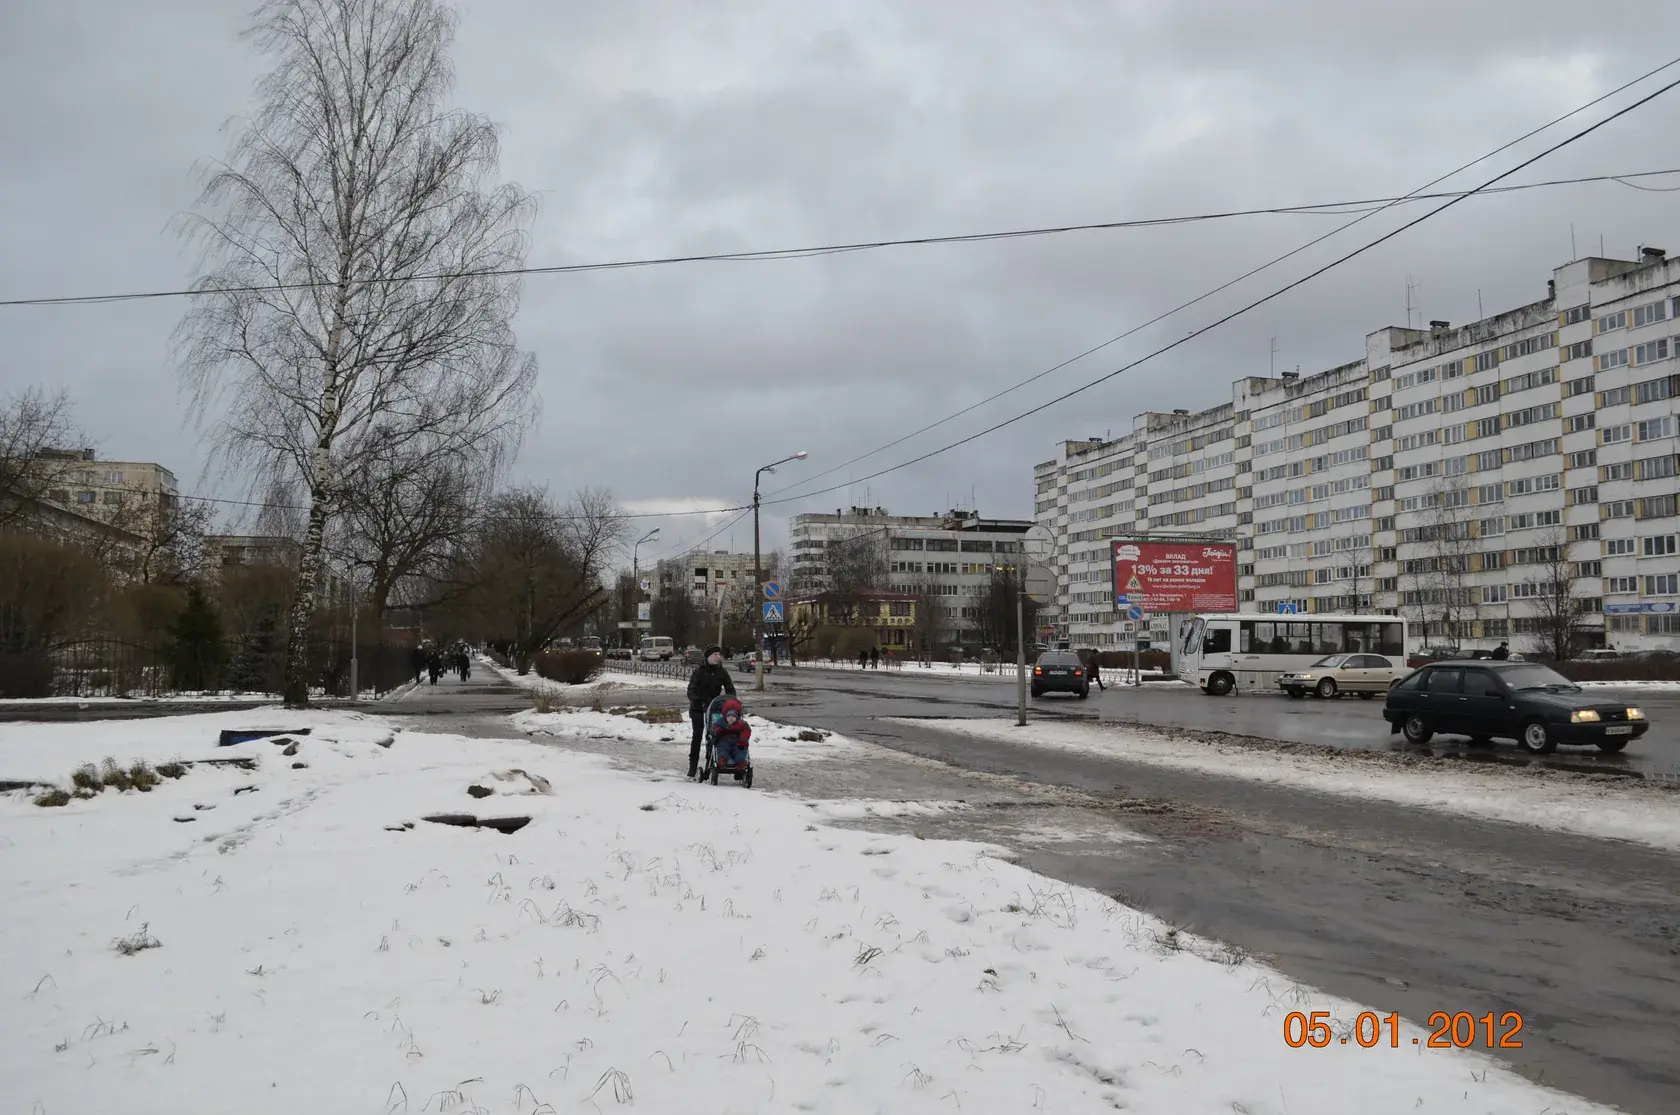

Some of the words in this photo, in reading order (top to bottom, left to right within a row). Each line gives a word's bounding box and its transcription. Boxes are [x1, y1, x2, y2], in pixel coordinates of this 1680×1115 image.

[1131, 564, 1158, 575] 13%
[1160, 567, 1172, 575] за
[1173, 565, 1190, 575] 33
